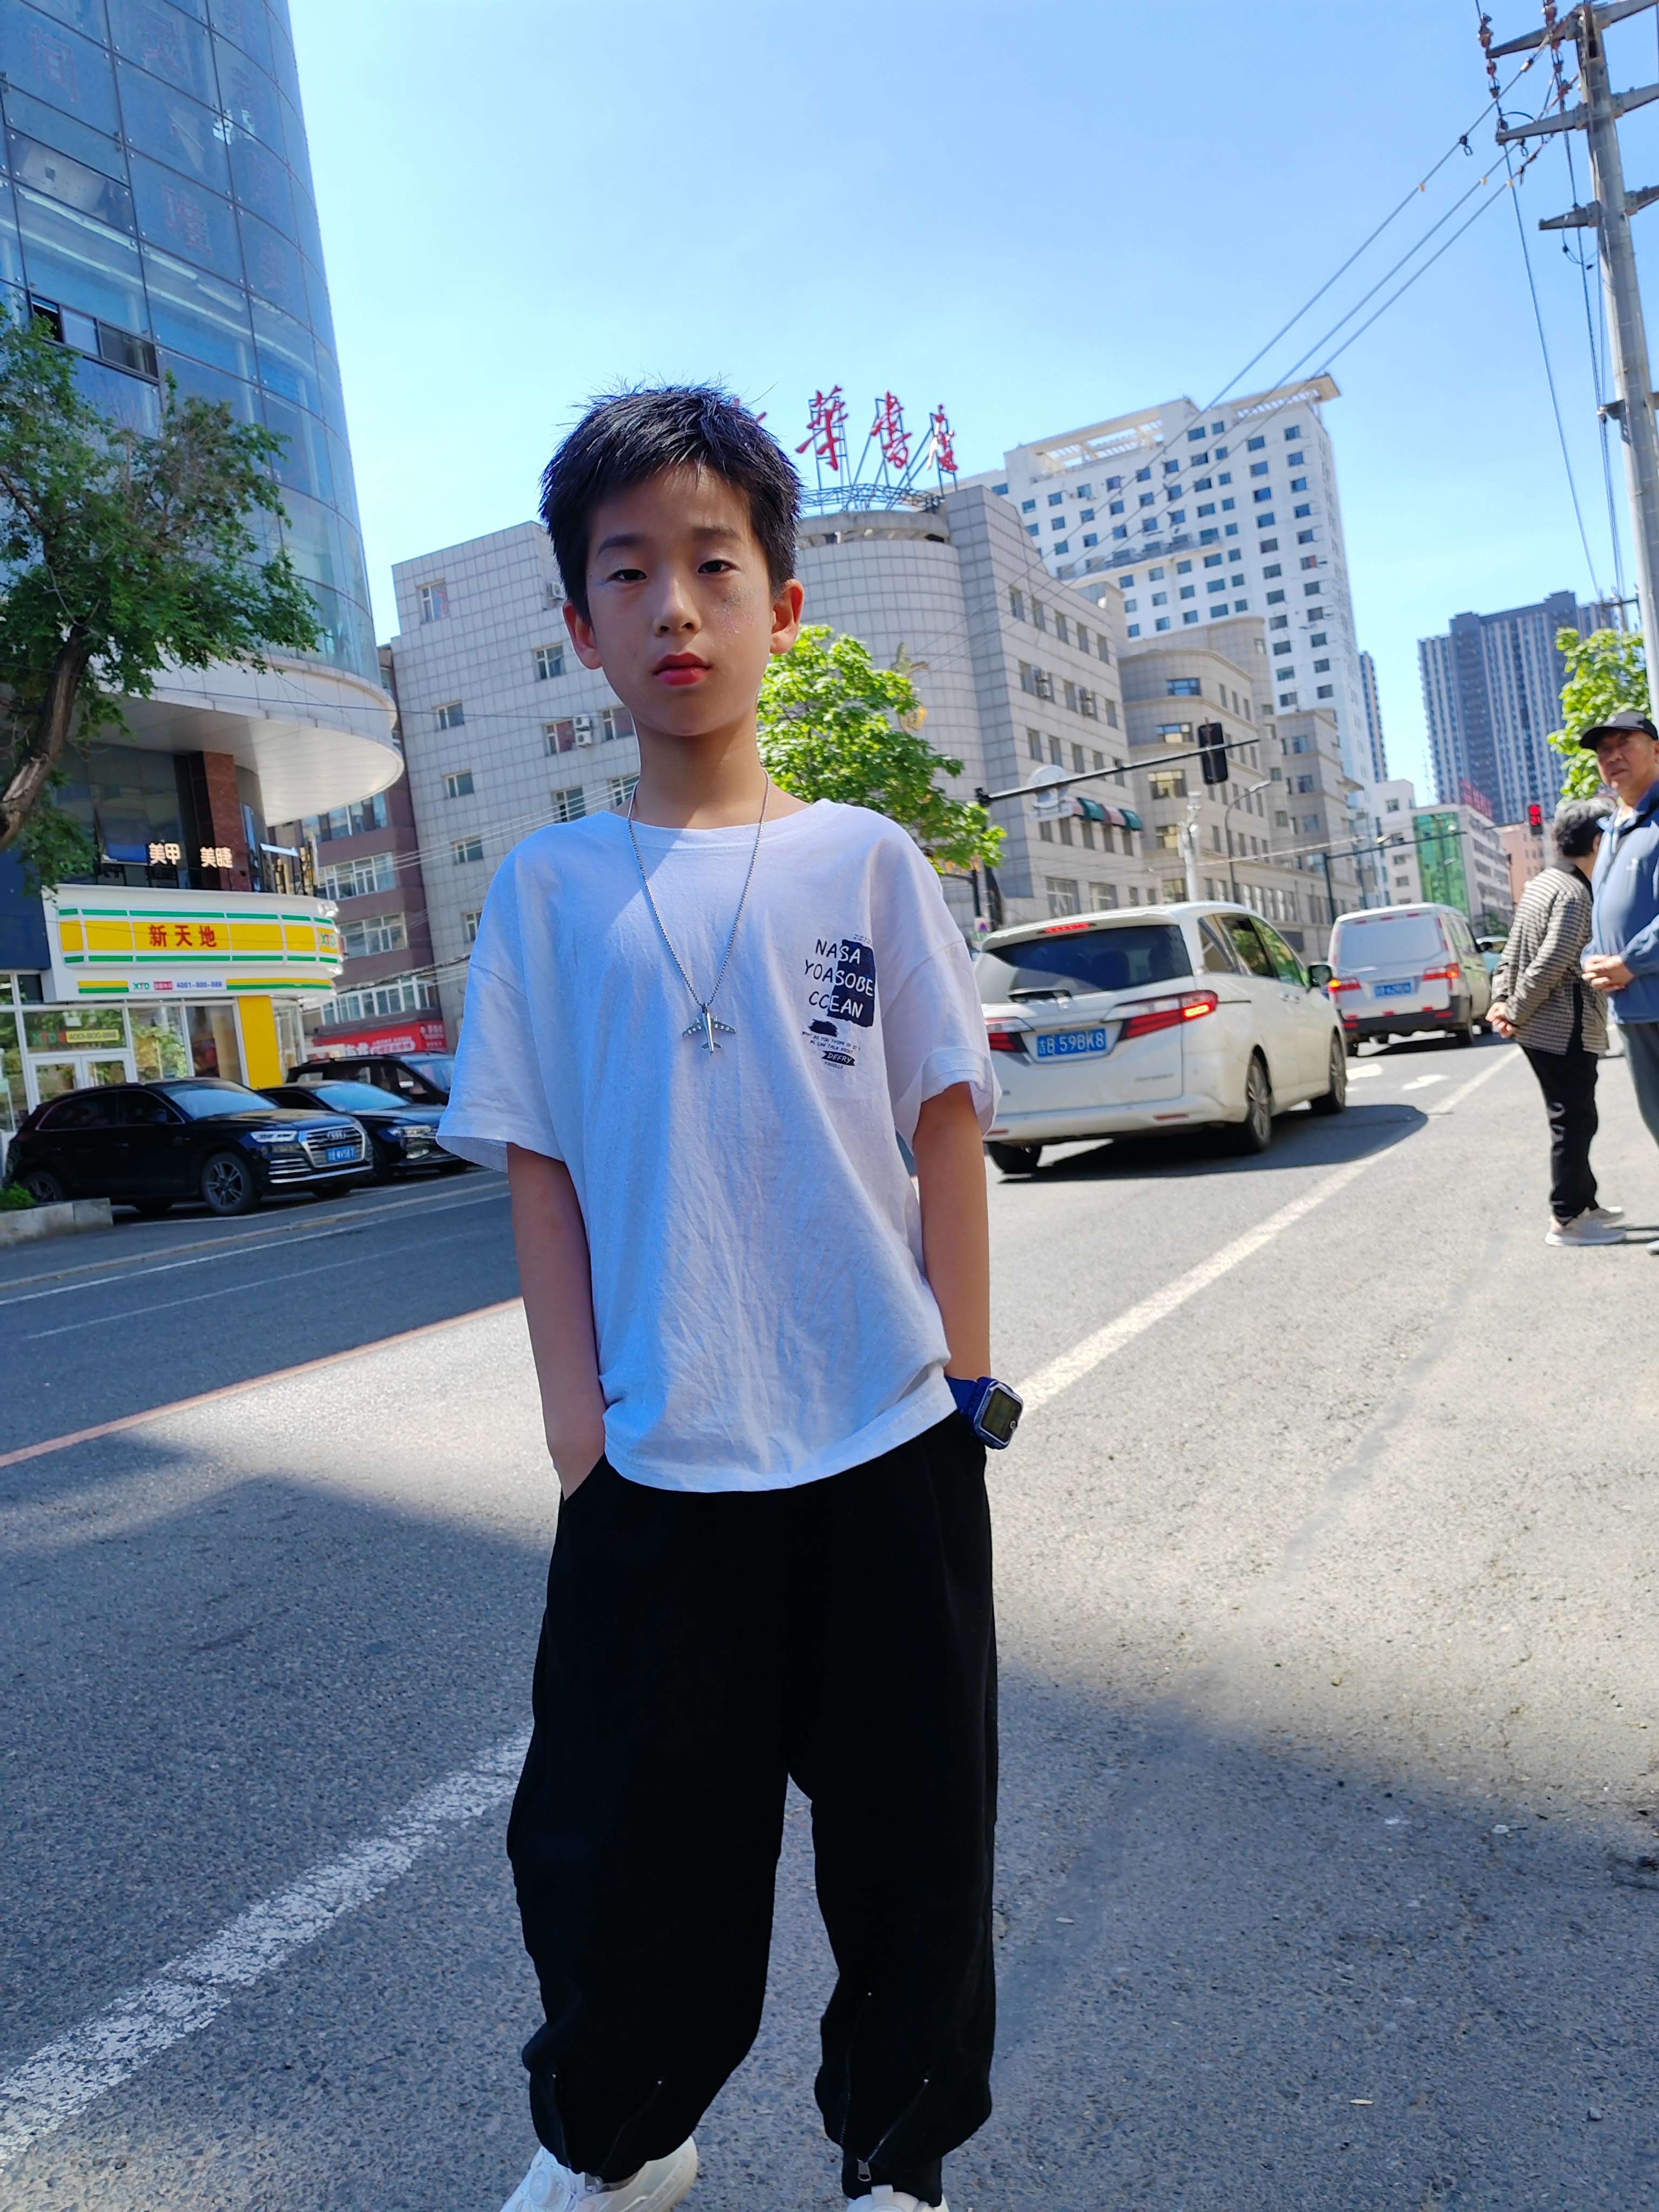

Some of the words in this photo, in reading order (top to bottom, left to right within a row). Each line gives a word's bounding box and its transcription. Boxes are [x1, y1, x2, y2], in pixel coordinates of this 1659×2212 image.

[148, 842, 181, 865] 美甲
[199, 846, 233, 869] 美睫
[149, 924, 217, 948] 新天地
[815, 938, 860, 965] NASA
[133, 982, 150, 990] XTD
[805, 959, 873, 997] YOASOBE
[808, 990, 863, 1019] CCEAN
[827, 1052, 852, 1064] DEFRY
